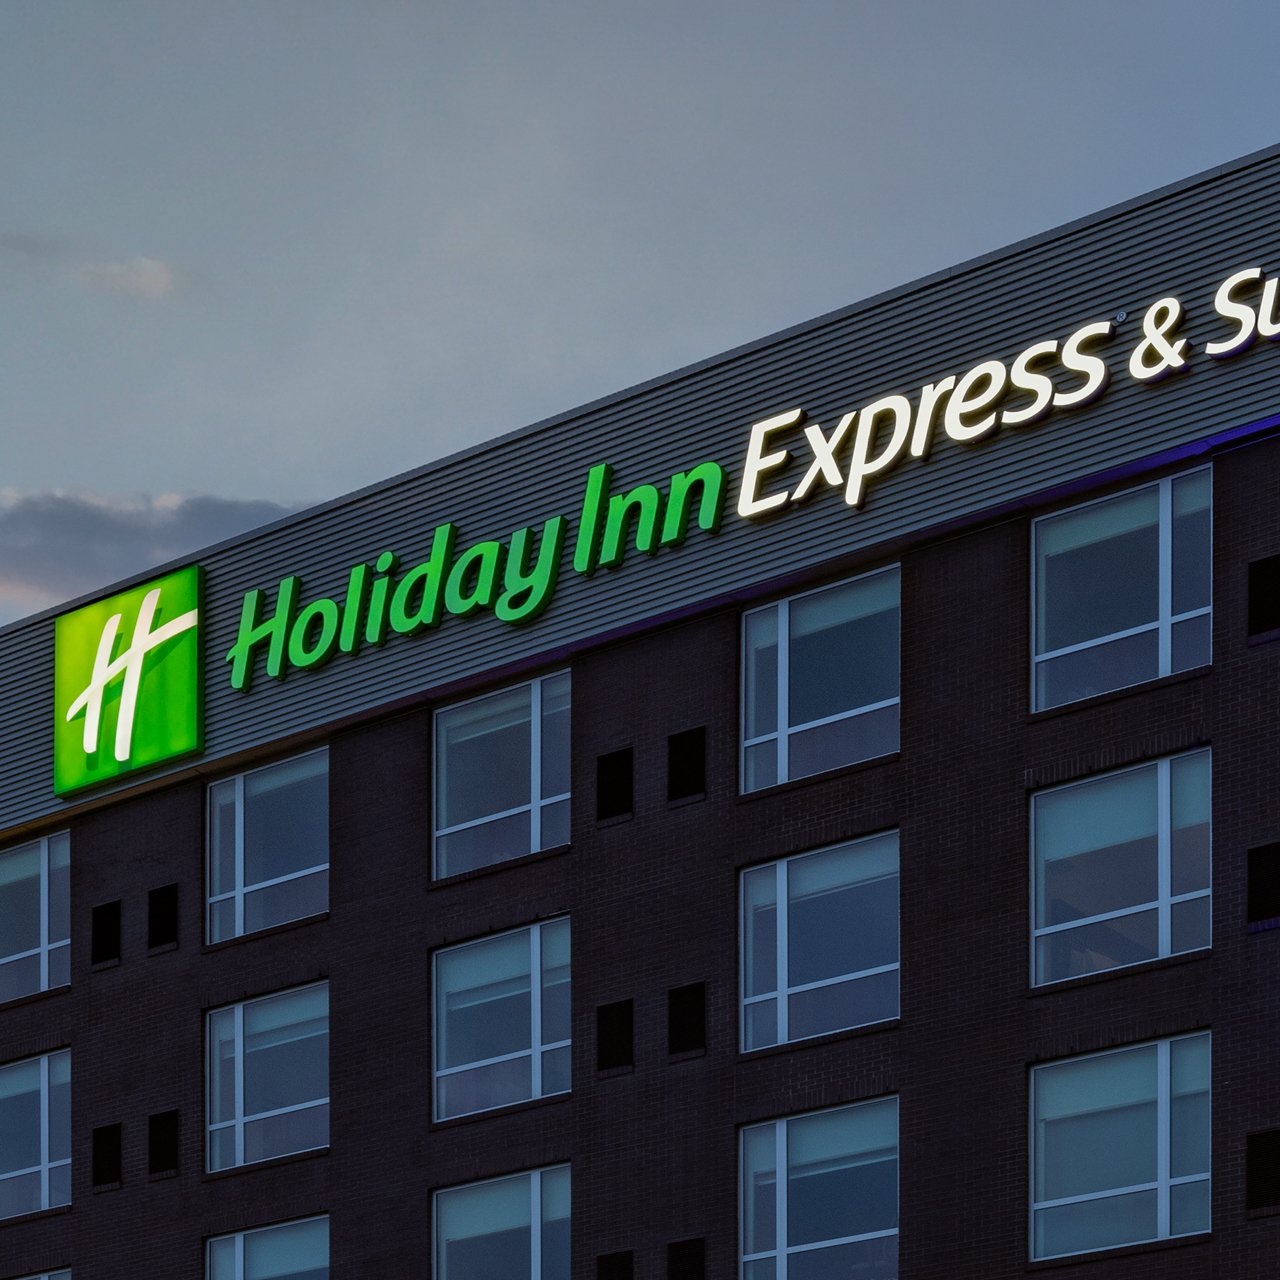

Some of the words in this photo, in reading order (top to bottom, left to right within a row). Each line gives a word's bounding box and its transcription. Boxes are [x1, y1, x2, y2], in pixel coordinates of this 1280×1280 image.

[226, 515, 569, 694] Holiday
[573, 462, 729, 576] Inn
[1129, 296, 1188, 380] &
